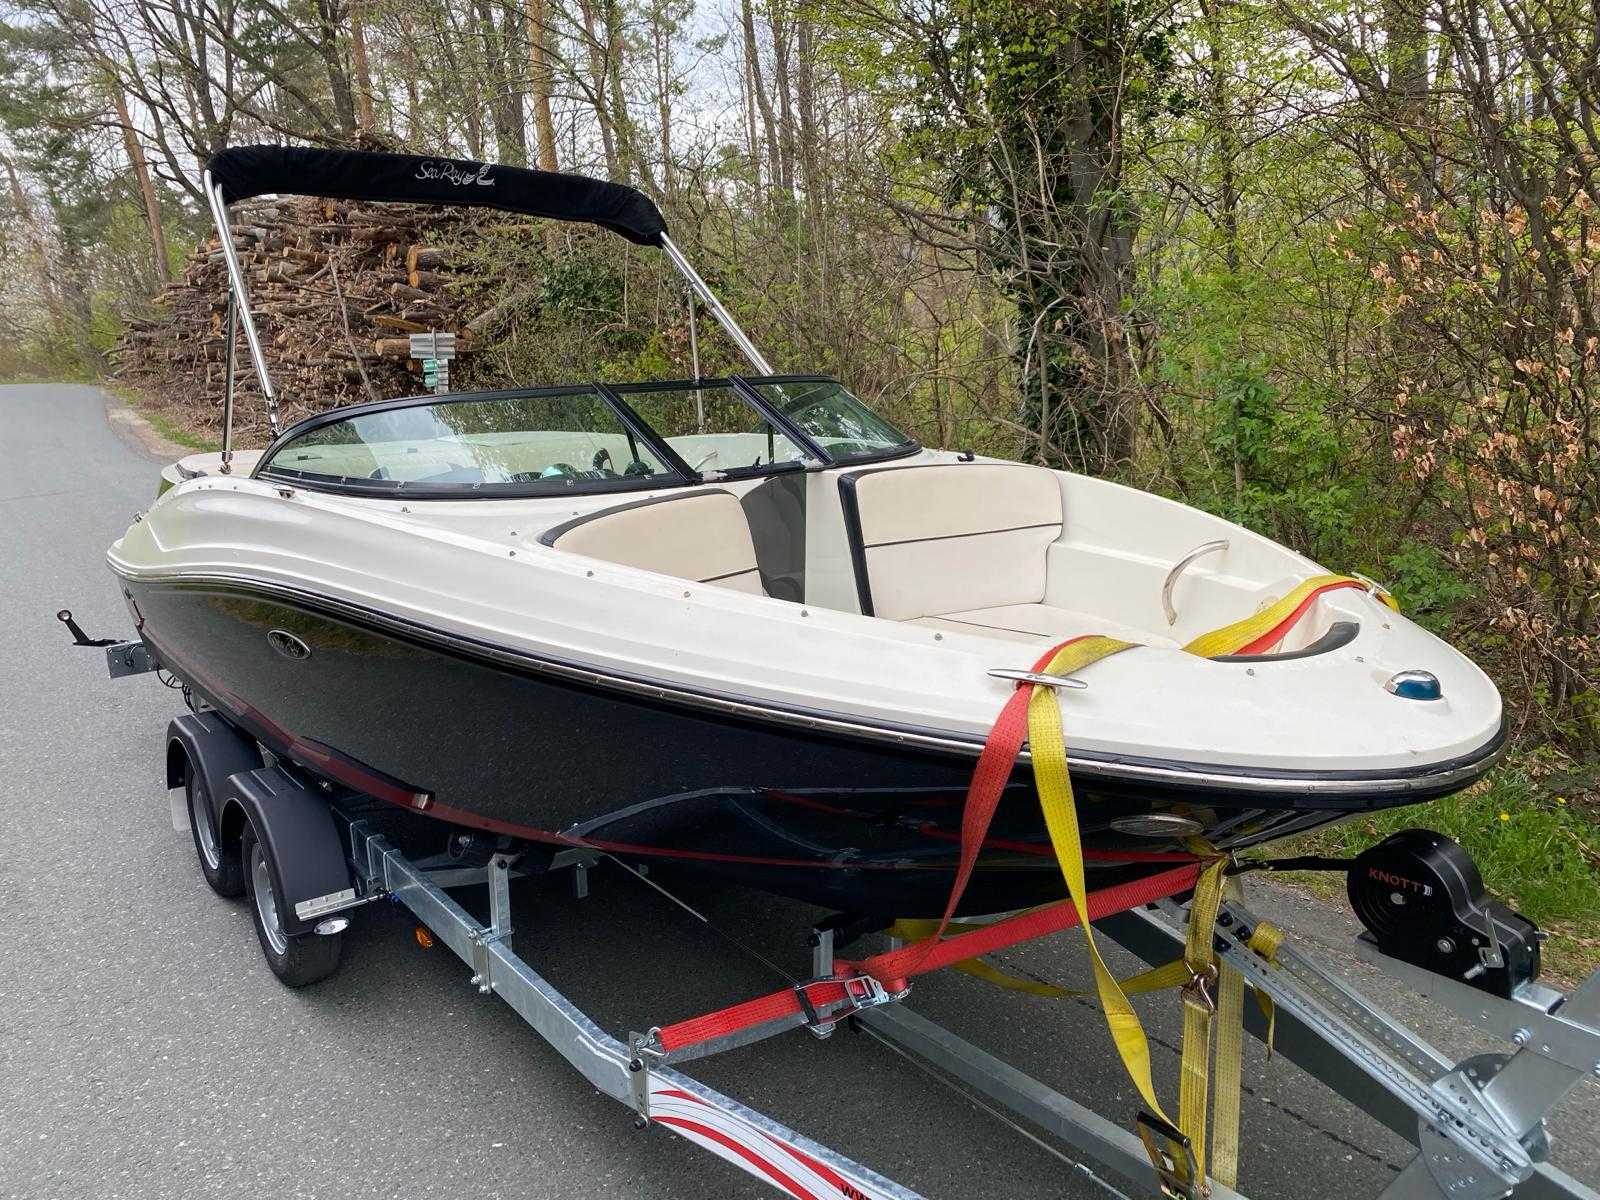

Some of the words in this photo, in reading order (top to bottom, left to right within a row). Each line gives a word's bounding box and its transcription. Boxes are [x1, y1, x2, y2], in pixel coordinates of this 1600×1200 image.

[415, 161, 440, 180] Sea
[440, 161, 466, 186] Ray
[1368, 867, 1422, 893] KNOTT
